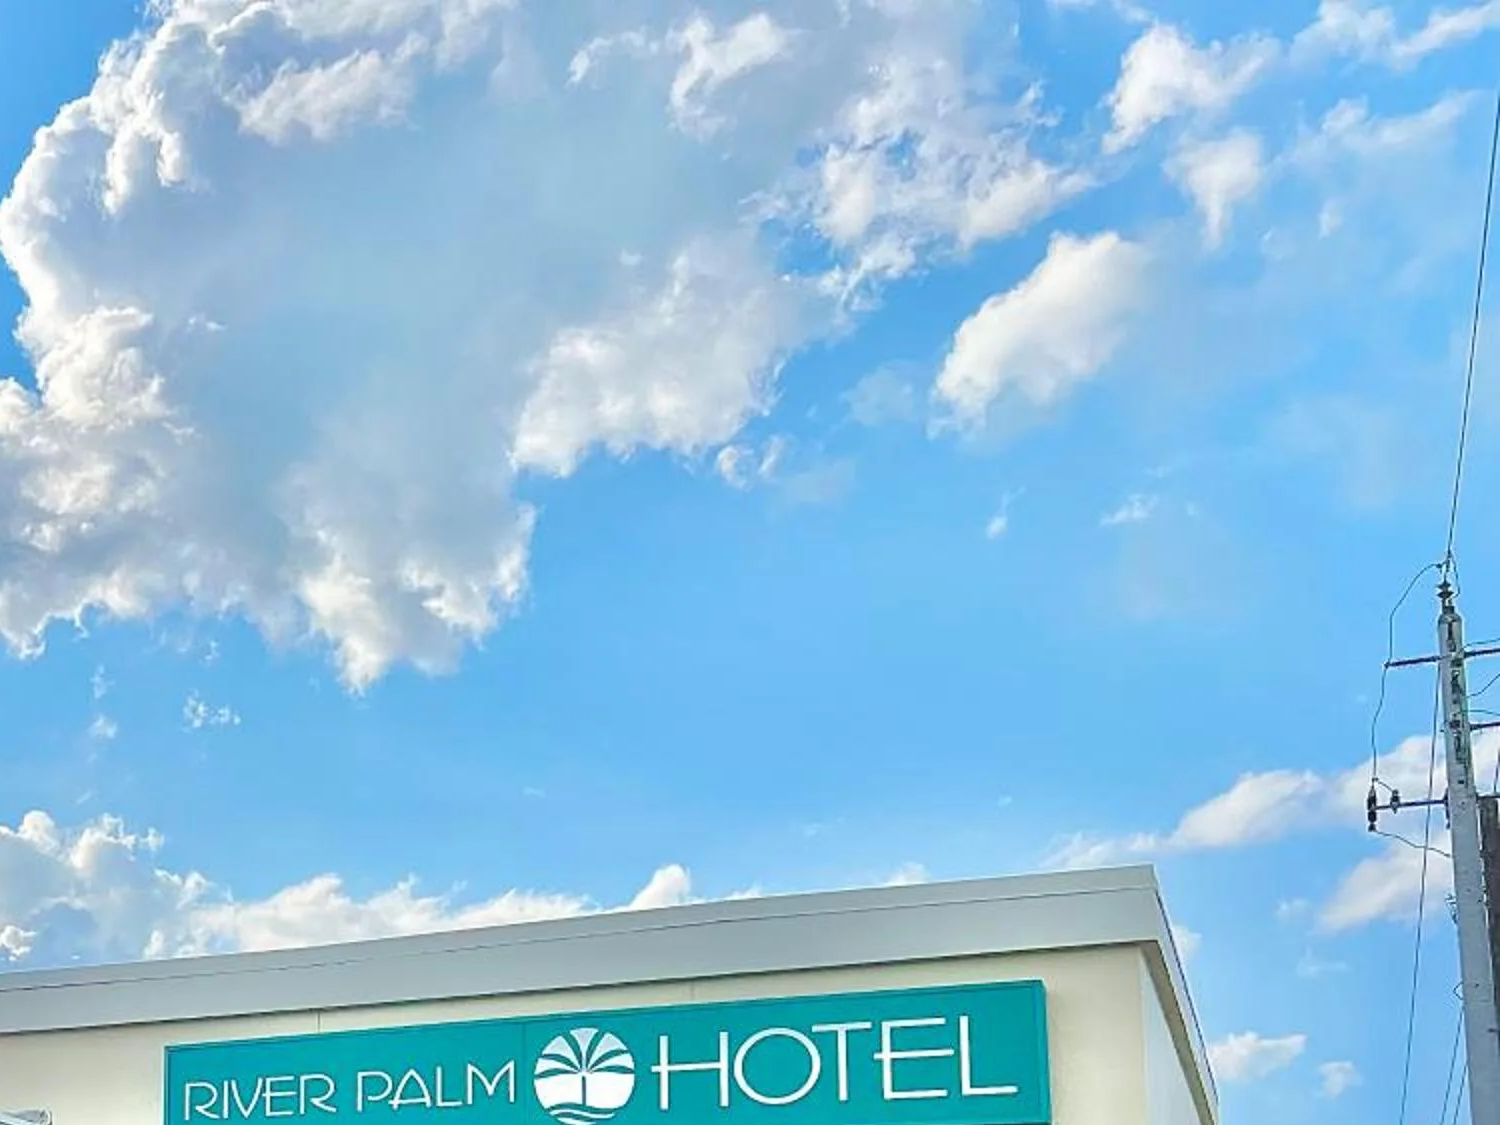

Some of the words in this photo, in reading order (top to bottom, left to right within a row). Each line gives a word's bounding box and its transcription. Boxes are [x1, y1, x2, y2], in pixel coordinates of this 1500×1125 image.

[183, 1073, 337, 1121] RIVER
[356, 1059, 516, 1112] PALM
[650, 1014, 1019, 1111] HOTEL
